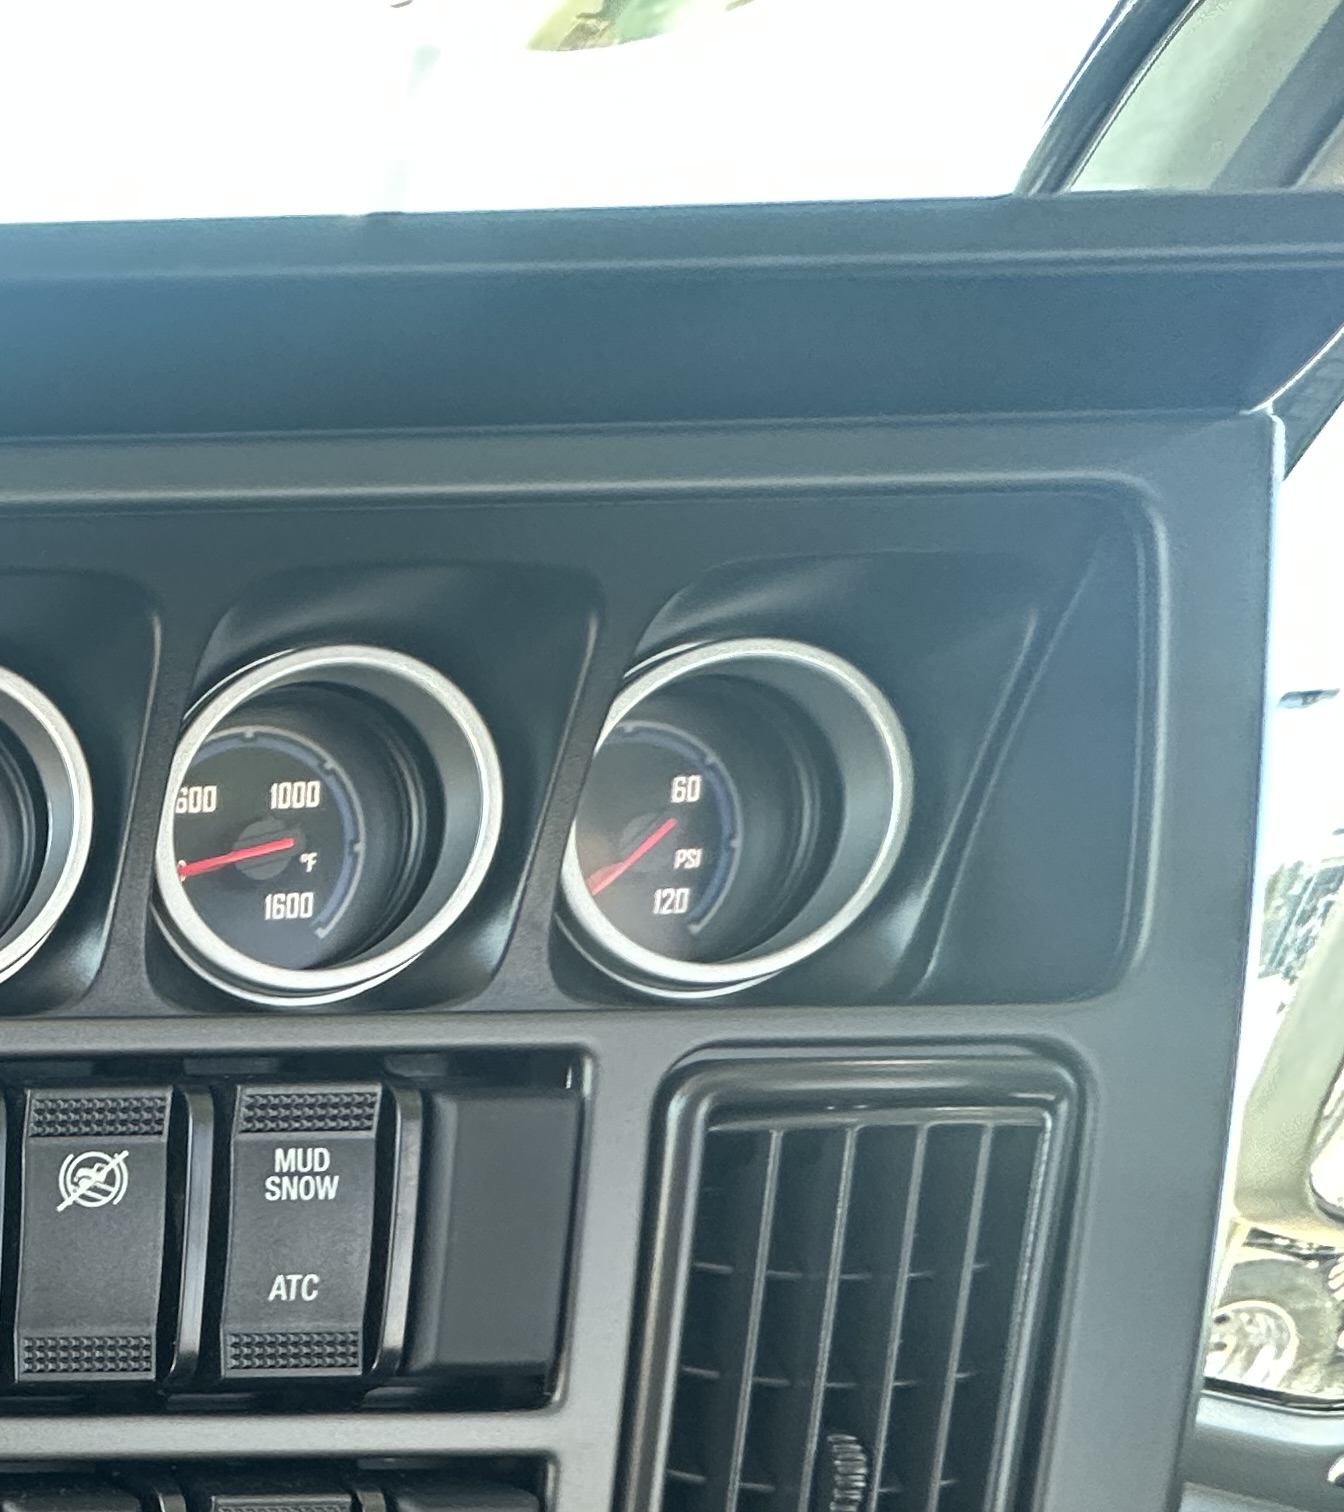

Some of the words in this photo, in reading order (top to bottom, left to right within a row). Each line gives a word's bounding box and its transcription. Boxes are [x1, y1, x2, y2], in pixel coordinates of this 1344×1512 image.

[175, 785, 217, 814] 600
[270, 780, 321, 809] 1000
[670, 775, 702, 803] 60
[673, 849, 703, 869] PSI
[264, 892, 314, 920] 1600
[652, 888, 690, 914] 120
[274, 1147, 331, 1173] MUD
[264, 1175, 339, 1201] SNOW
[267, 1274, 321, 1302] ATC
